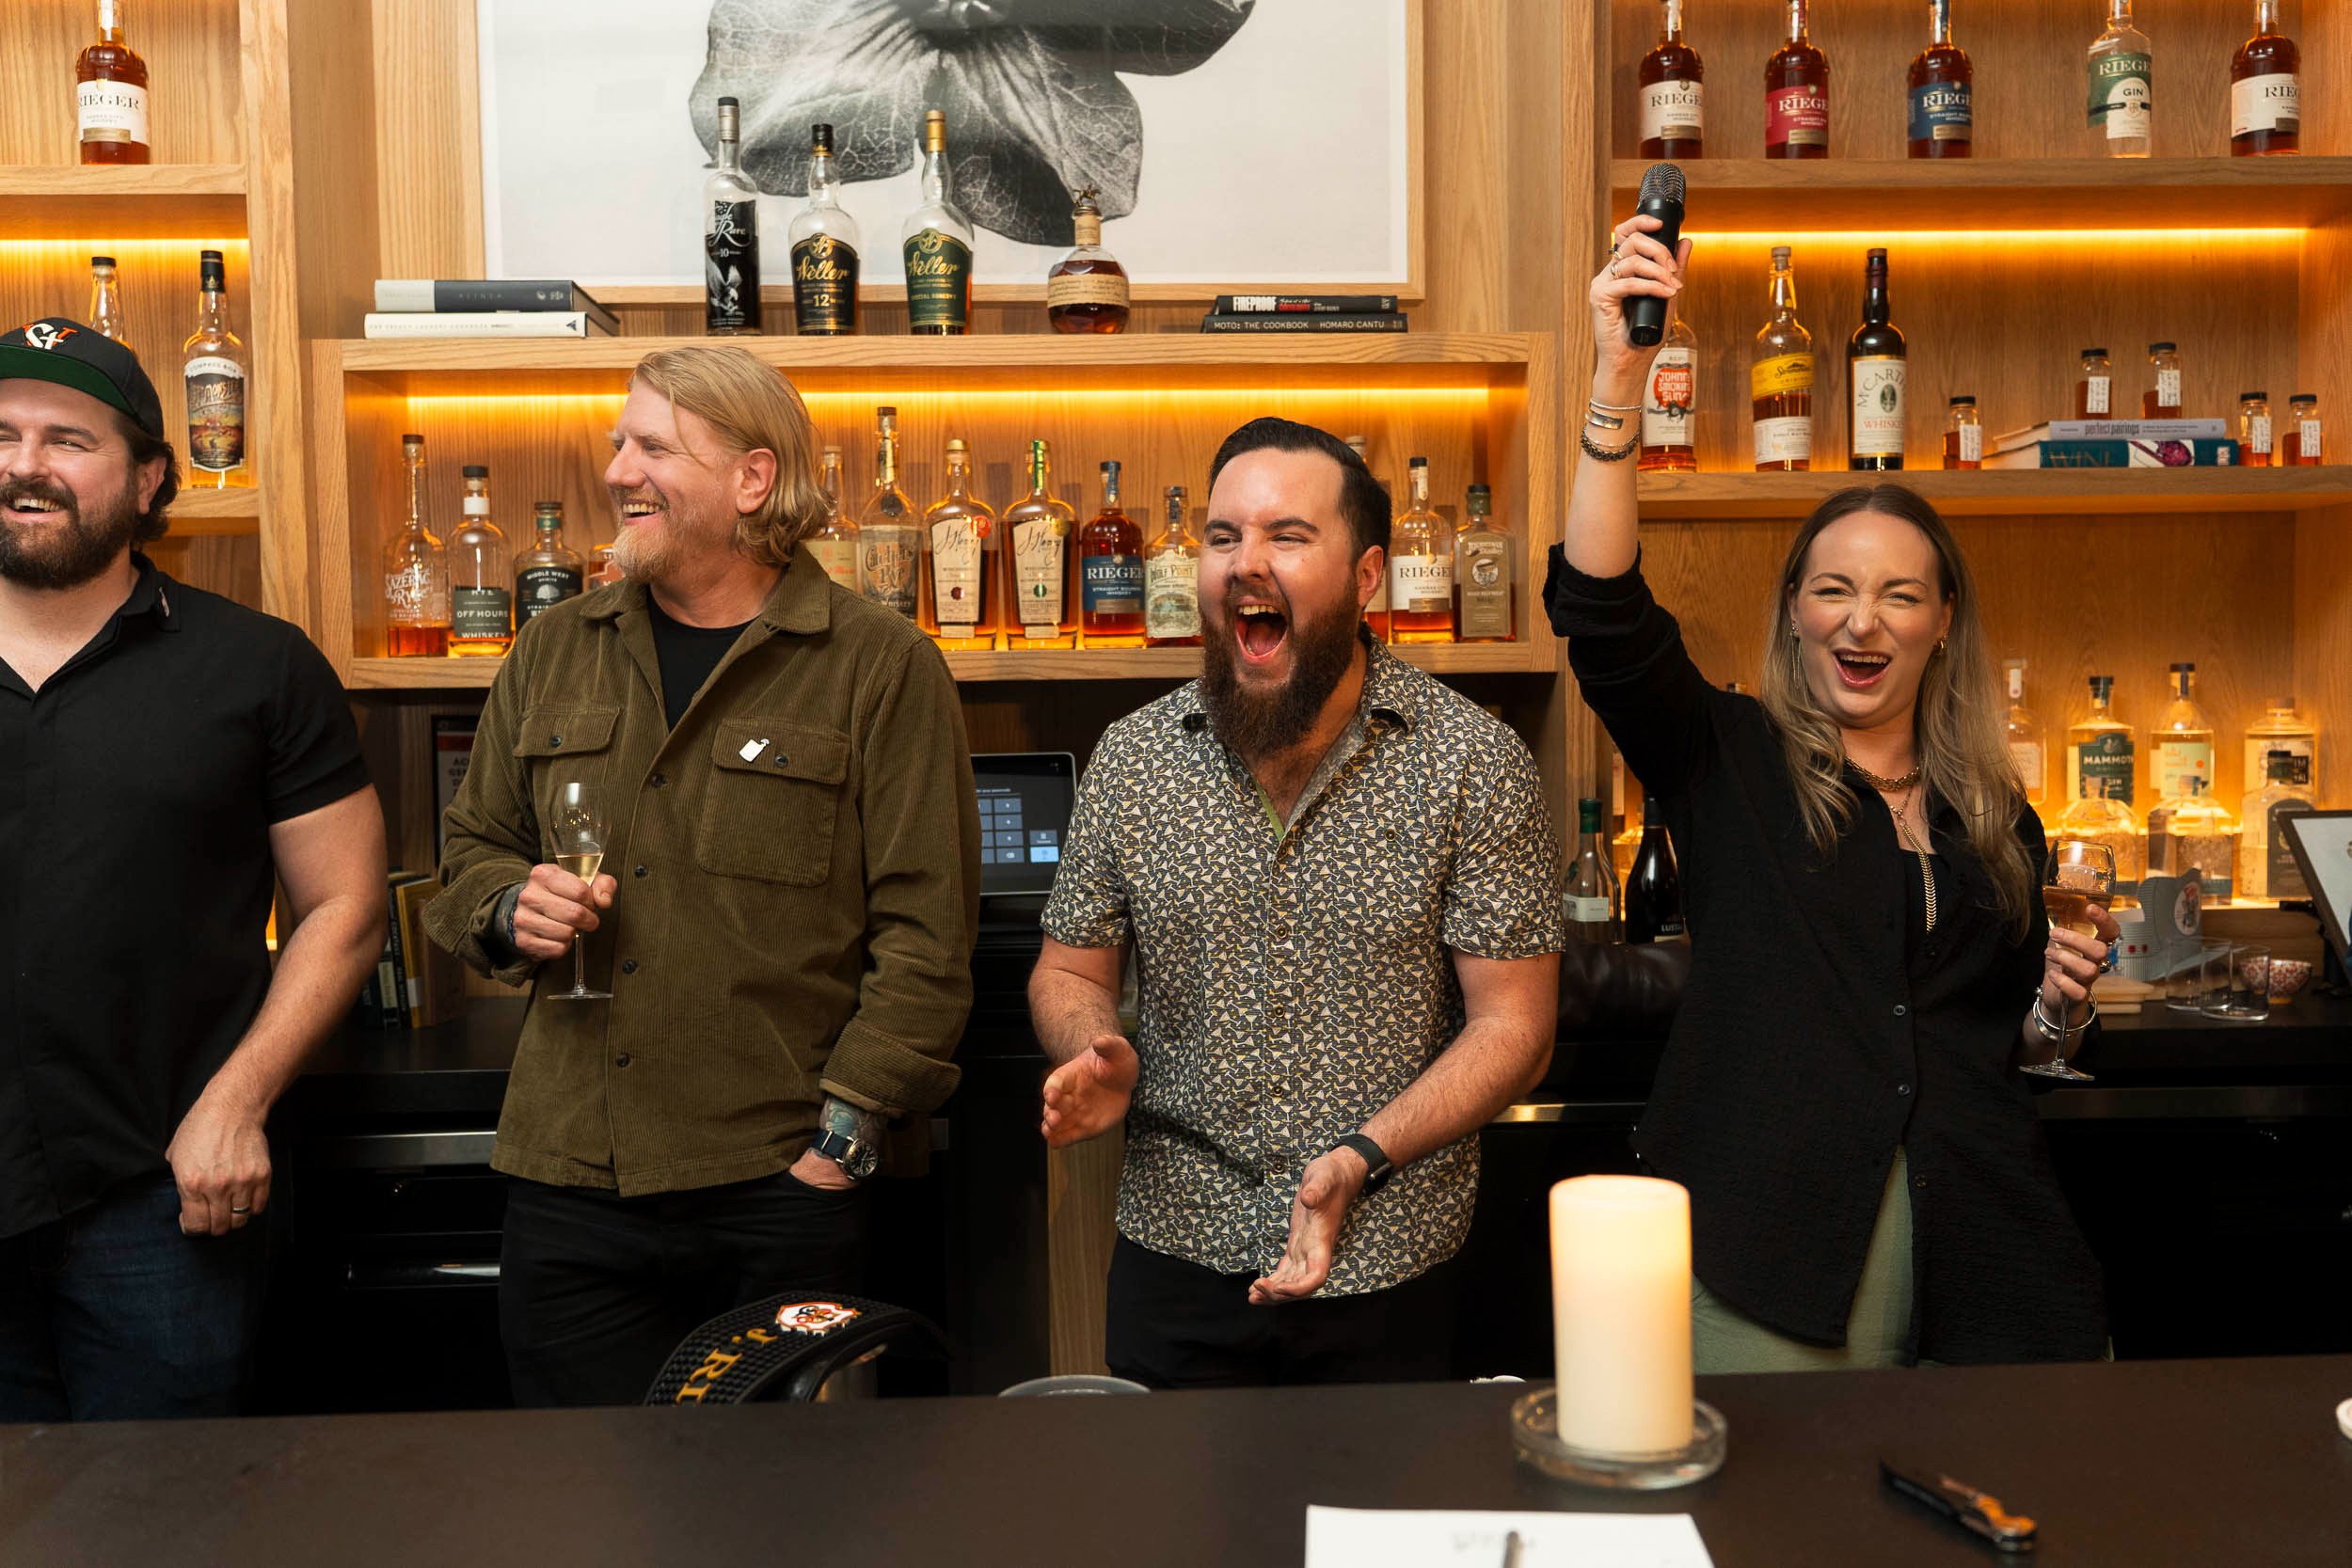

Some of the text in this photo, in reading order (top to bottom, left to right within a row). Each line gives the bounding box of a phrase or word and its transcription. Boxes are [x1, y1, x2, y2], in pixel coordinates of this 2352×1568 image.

[2122, 88, 2144, 97] GIN
[720, 247, 729, 258] 10
[796, 255, 850, 281] Weller
[907, 250, 960, 277] Weller
[813, 293, 830, 308] 12
[1232, 296, 1277, 312] FIREPROOF
[1263, 321, 1309, 329] COOKBOOK
[1319, 321, 1355, 329] HOMARO
[1356, 320, 1385, 328] CANTU
[2084, 422, 2110, 436] perfect
[2110, 423, 2140, 436] pairings
[526, 570, 570, 580] MIDDLE WEST
[1087, 567, 1143, 580] RIEGER
[456, 610, 509, 618] OFF HOURS
